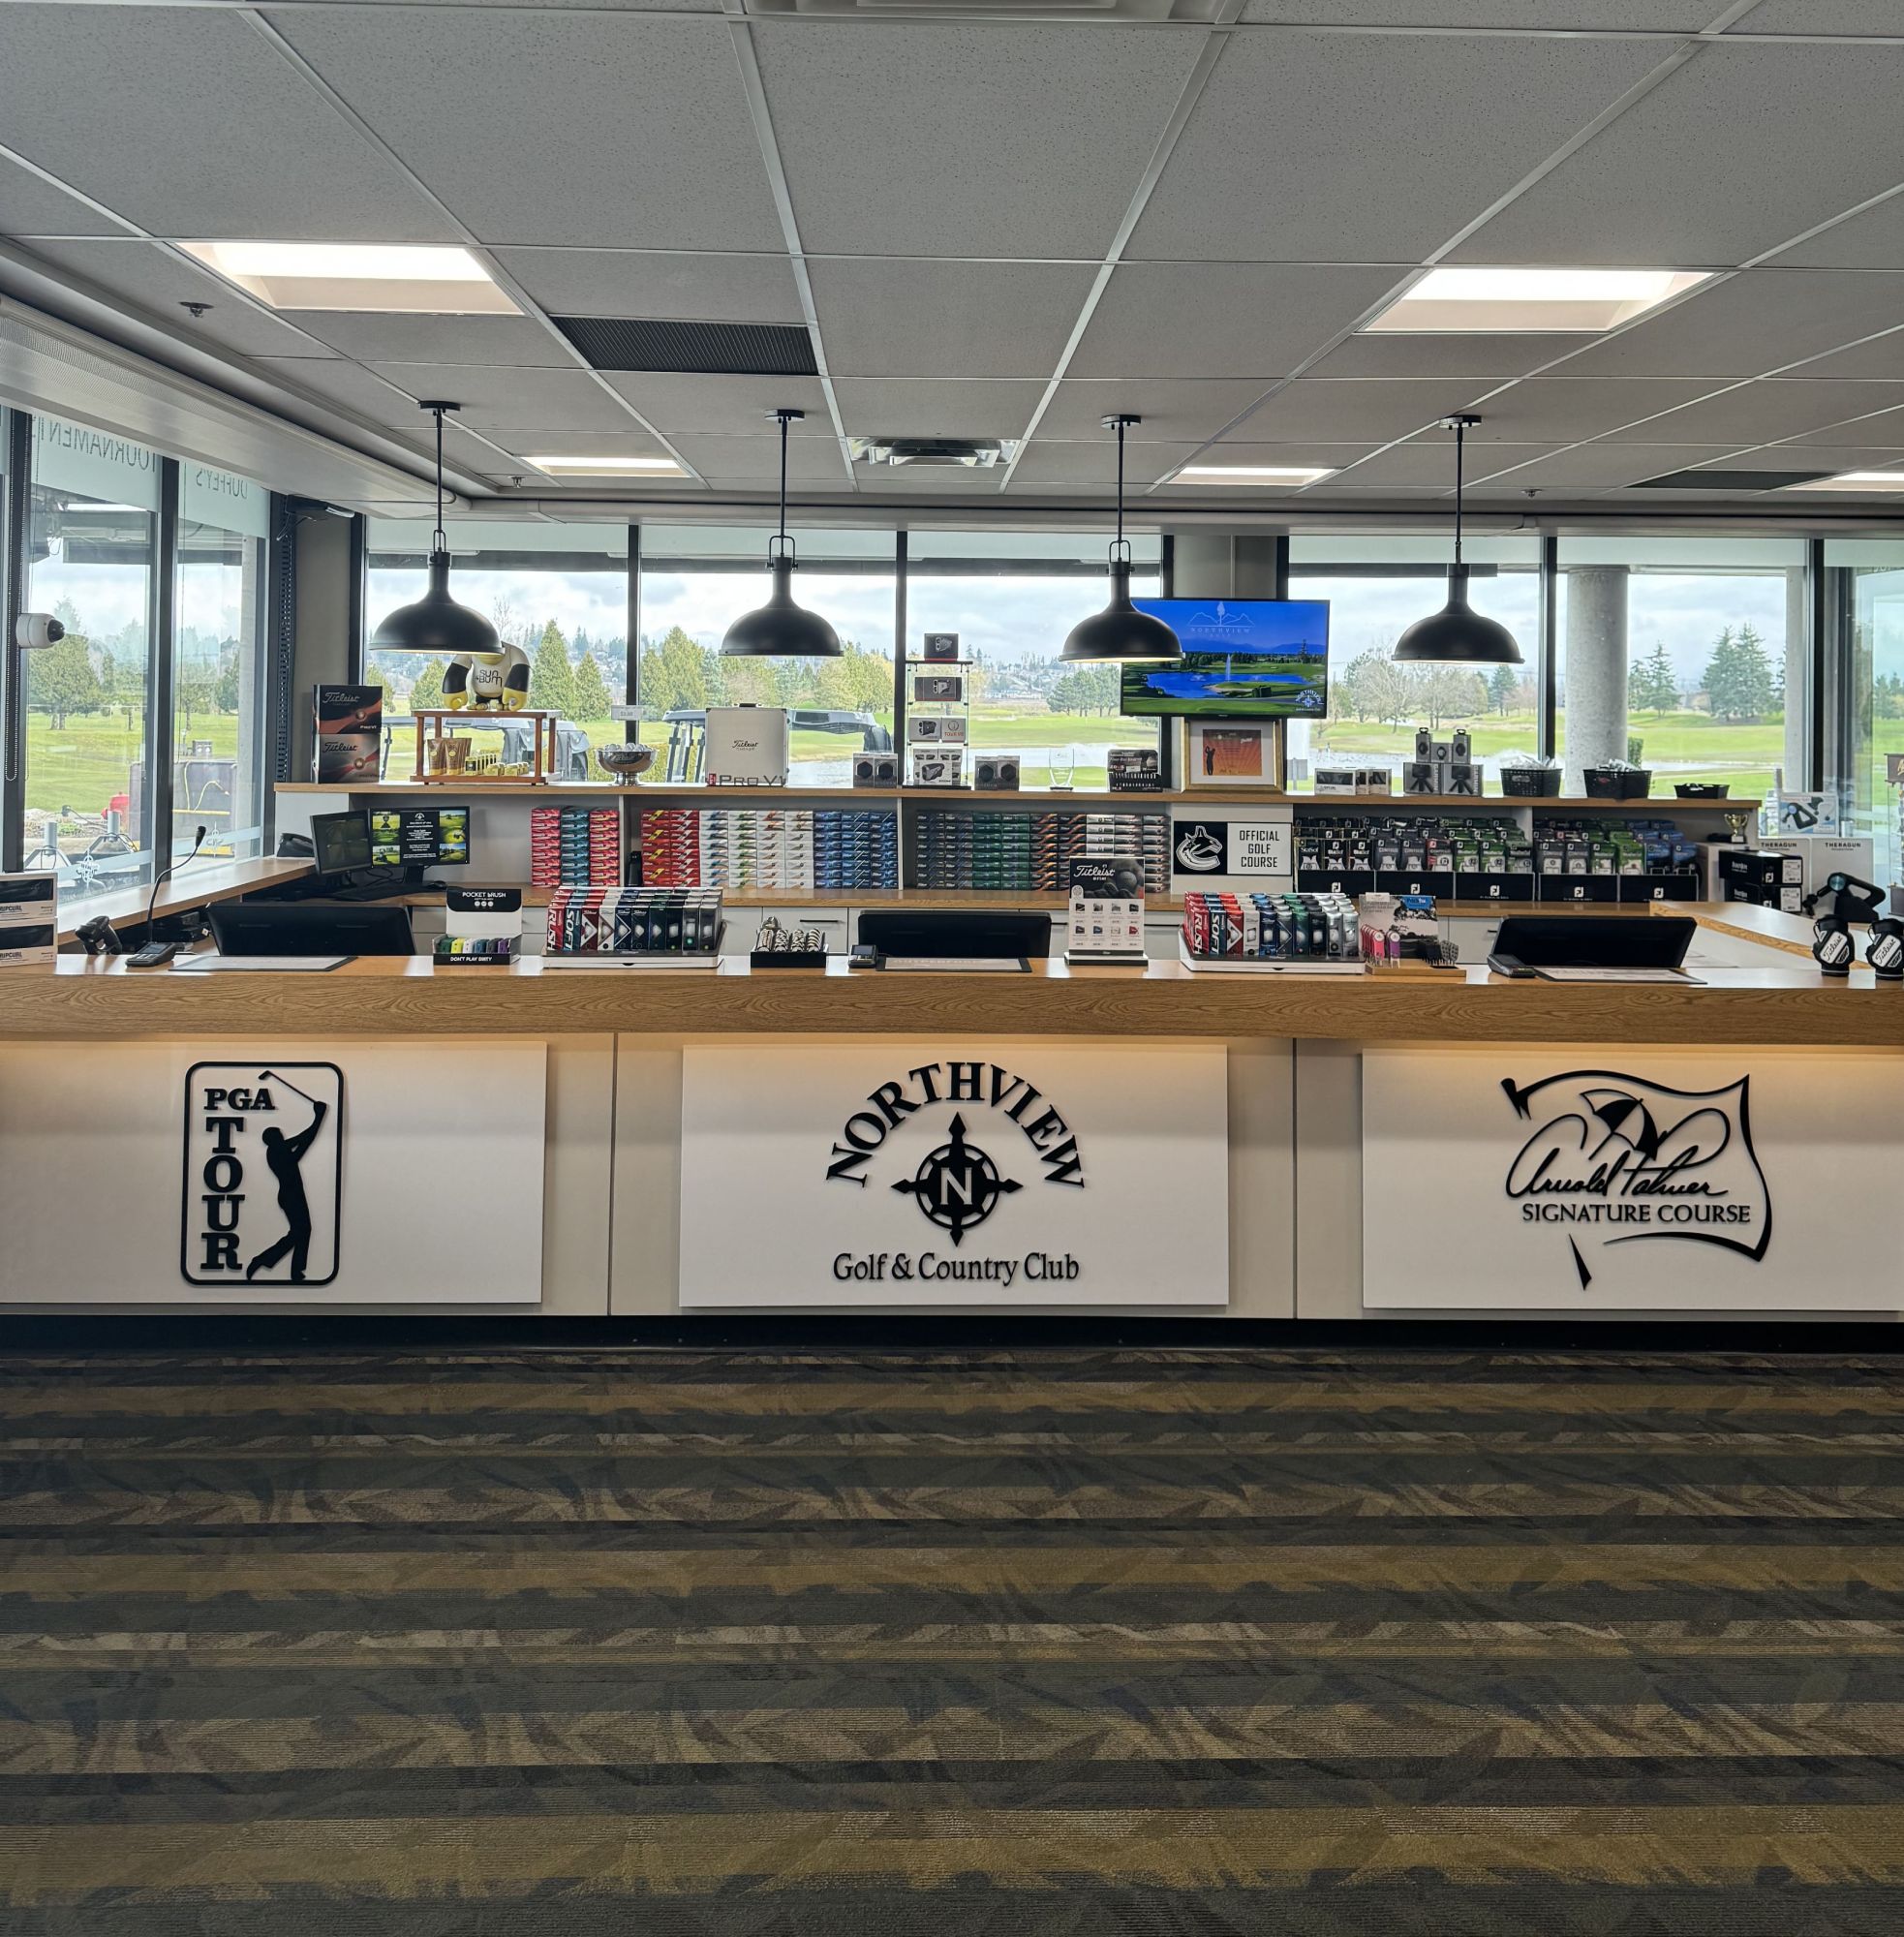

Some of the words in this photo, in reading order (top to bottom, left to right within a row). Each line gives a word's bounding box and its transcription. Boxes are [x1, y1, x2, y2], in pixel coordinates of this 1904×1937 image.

[322, 692, 360, 703] Titleist
[322, 741, 358, 753] Titleist
[1240, 830, 1280, 841] OFFICIAL
[1248, 844, 1272, 854] GOLF
[1074, 865, 1116, 877] Titleist
[1241, 856, 1277, 868] COURSE
[1411, 883, 1421, 894] FJ
[1490, 885, 1500, 896] FJ
[1574, 887, 1583, 897] FJ
[1654, 888, 1664, 898] FJ
[547, 909, 557, 950] RUSH
[565, 909, 573, 951] SOFT
[1194, 913, 1203, 954] RUSH
[1823, 936, 1843, 961] Titleist
[1876, 938, 1896, 965] Titleist
[203, 1088, 276, 1111] PGA
[826, 1061, 1085, 1188] NORTHVIEW
[200, 1117, 246, 1270] TOUR
[940, 1167, 972, 1205] N
[1522, 1203, 1650, 1222] SIGNATURE
[1657, 1204, 1751, 1222] COURSE
[833, 1252, 888, 1280] Golf
[891, 1252, 914, 1279] &
[918, 1251, 1019, 1287] Country
[1024, 1251, 1080, 1279] Club
